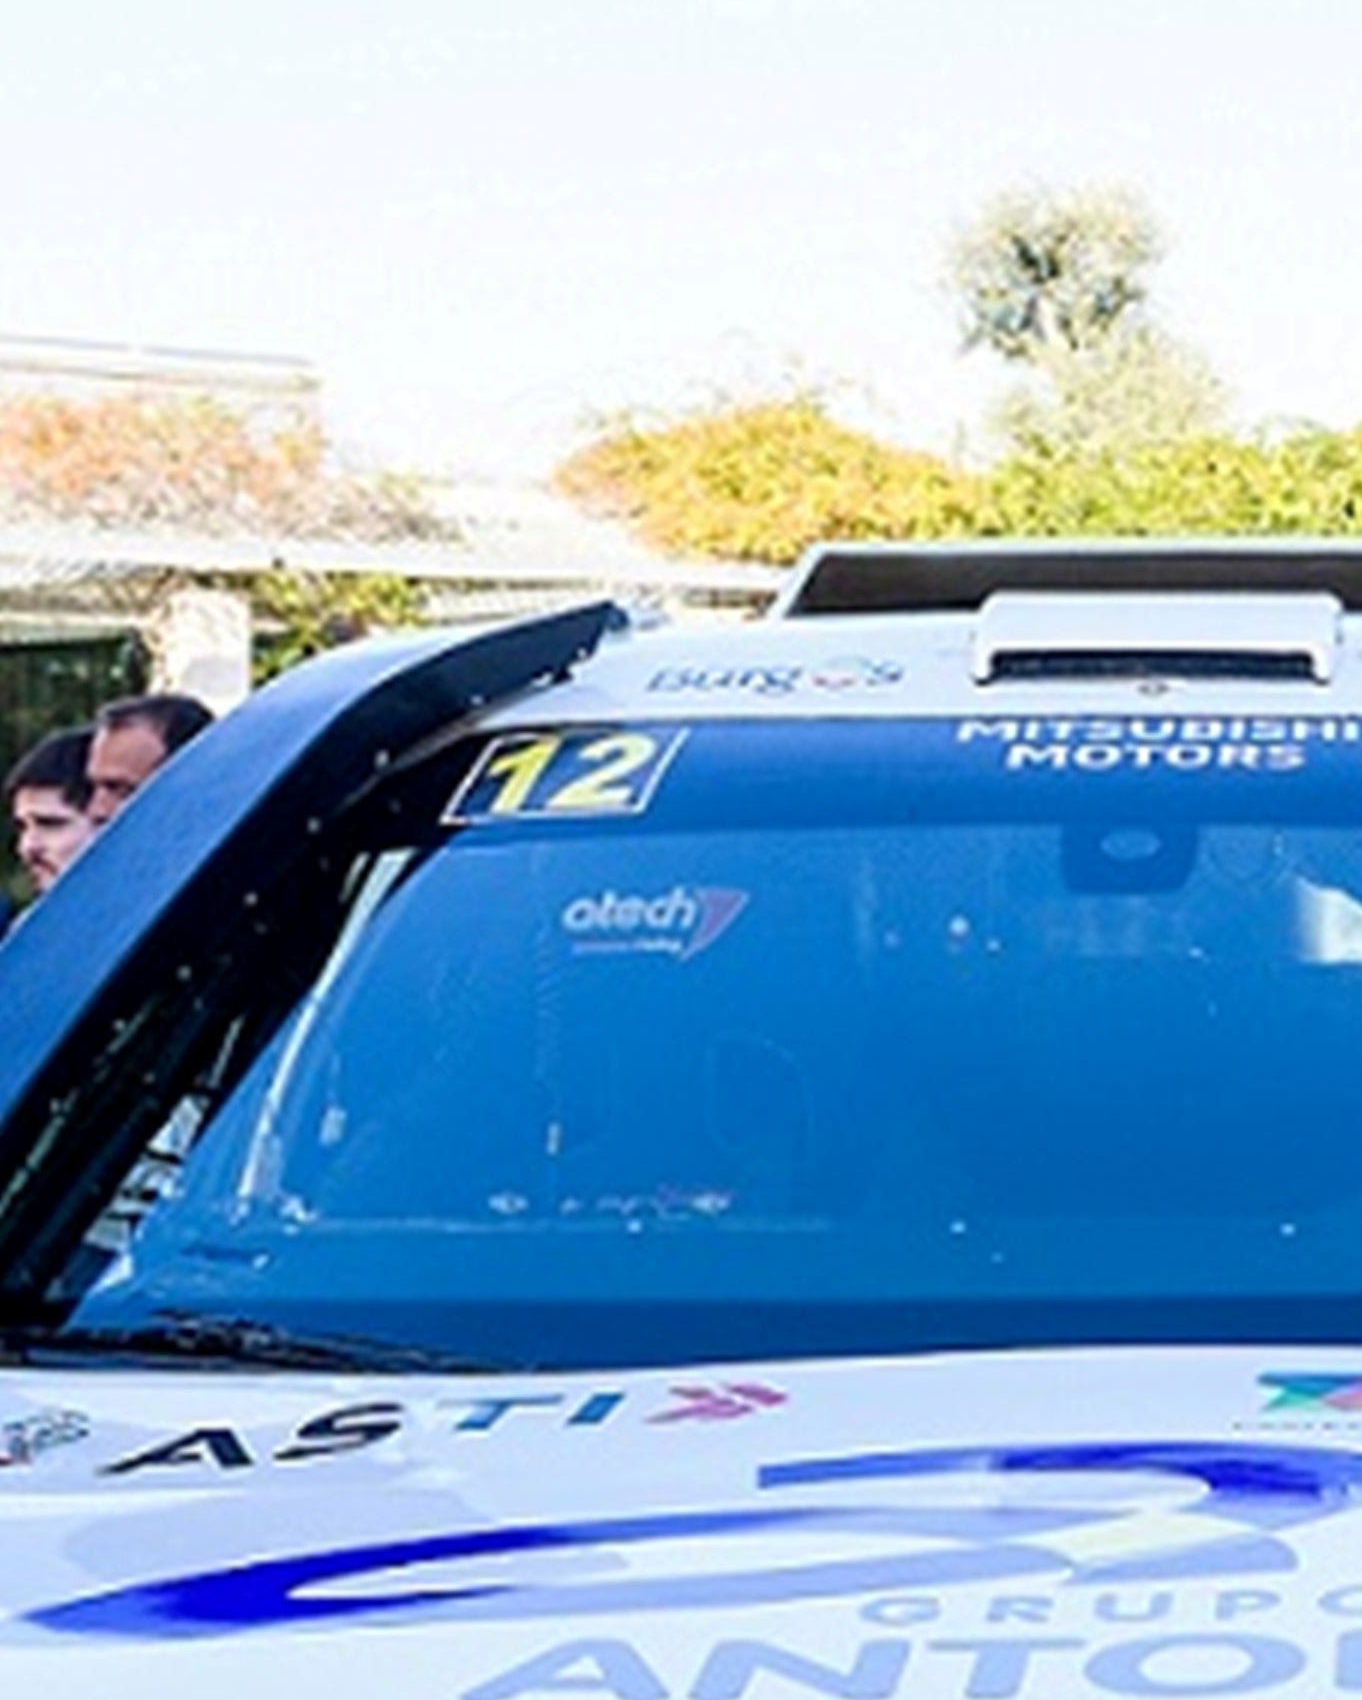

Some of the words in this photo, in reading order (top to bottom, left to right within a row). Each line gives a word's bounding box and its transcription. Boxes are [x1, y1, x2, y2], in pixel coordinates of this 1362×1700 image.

[956, 718, 1362, 743] MITSUBISHI
[1006, 743, 1305, 771] MOTORS
[484, 732, 658, 814] 12
[96, 1391, 627, 1477] ASTI
